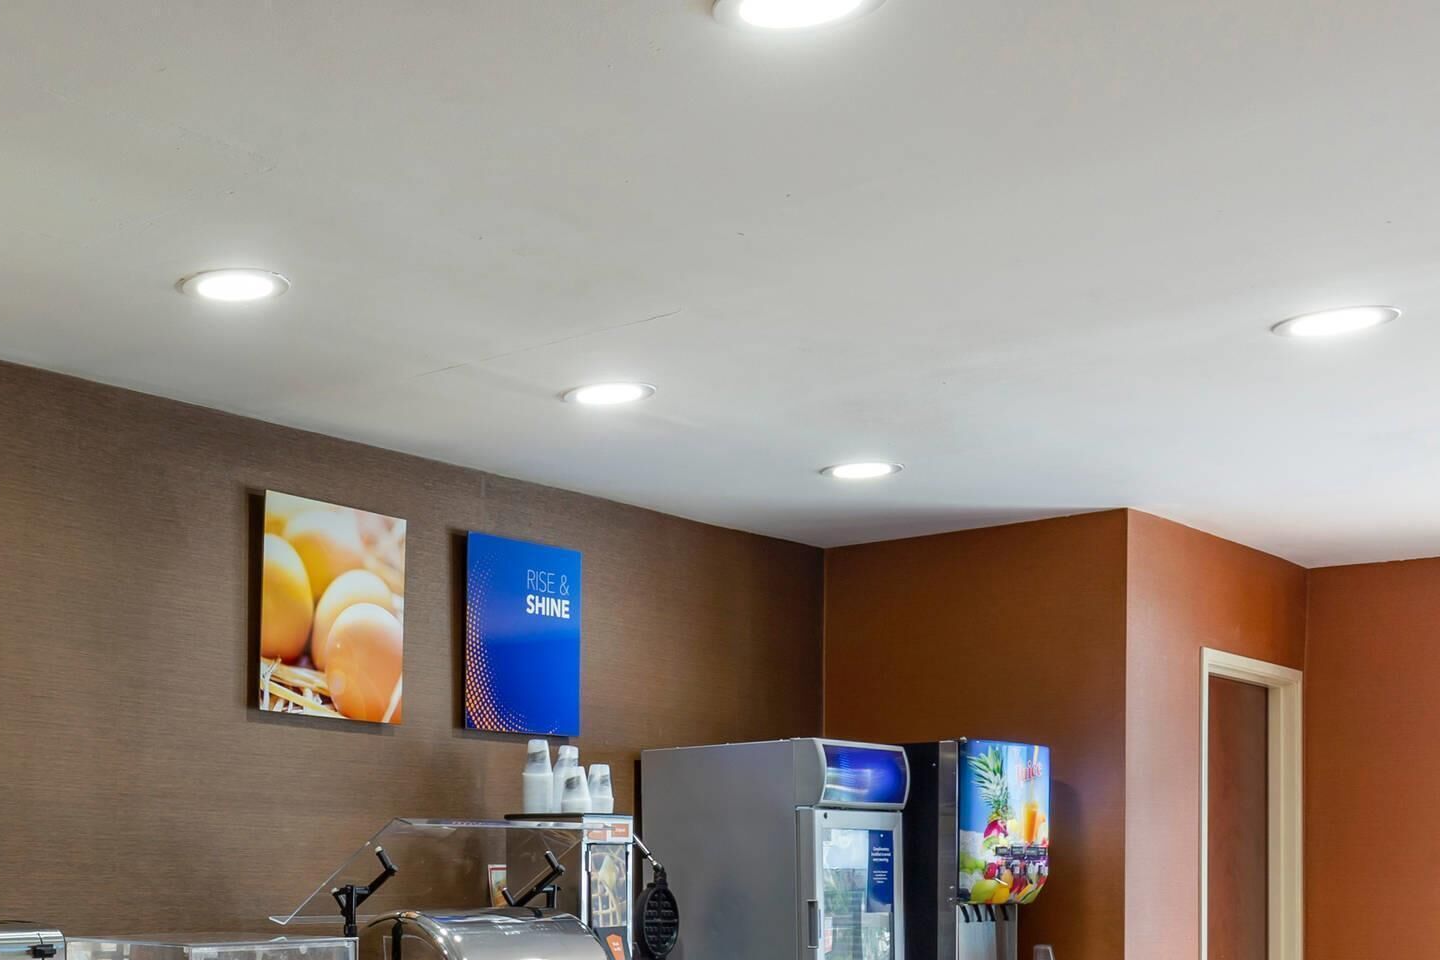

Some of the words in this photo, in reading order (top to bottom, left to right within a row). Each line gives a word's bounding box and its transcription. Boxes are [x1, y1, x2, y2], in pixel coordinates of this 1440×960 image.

[527, 569, 556, 594] RISE
[559, 574, 570, 596] &
[526, 594, 570, 619] SHINE
